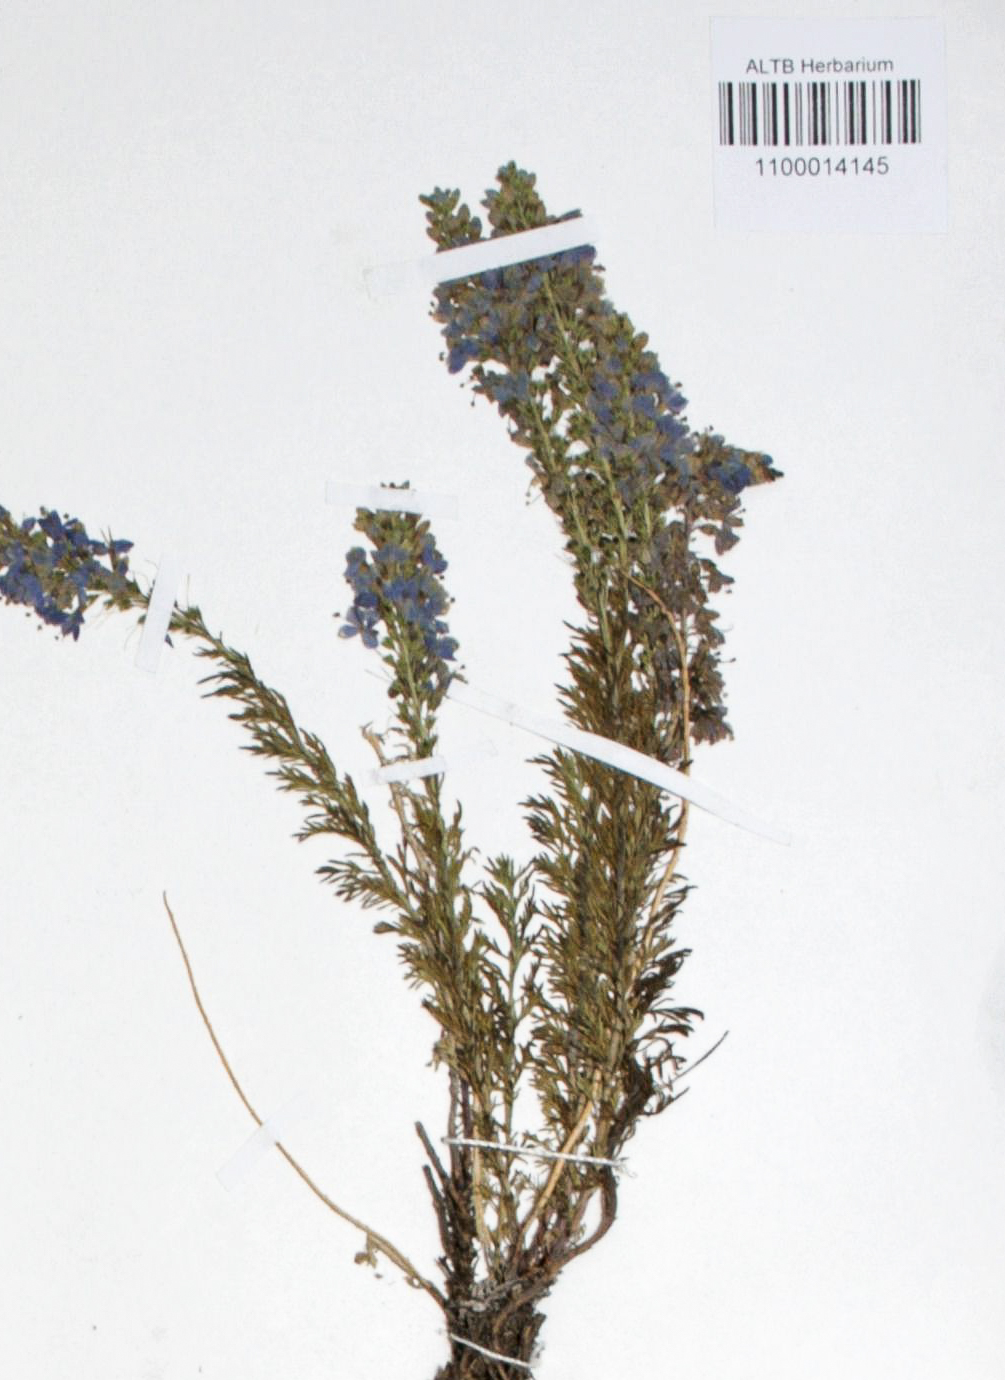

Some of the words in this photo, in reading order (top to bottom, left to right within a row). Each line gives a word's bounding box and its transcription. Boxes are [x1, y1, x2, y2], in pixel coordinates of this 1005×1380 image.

[746, 58, 794, 74] ALTB
[801, 57, 894, 73] Herbarium
[756, 156, 889, 176] 1100014145
